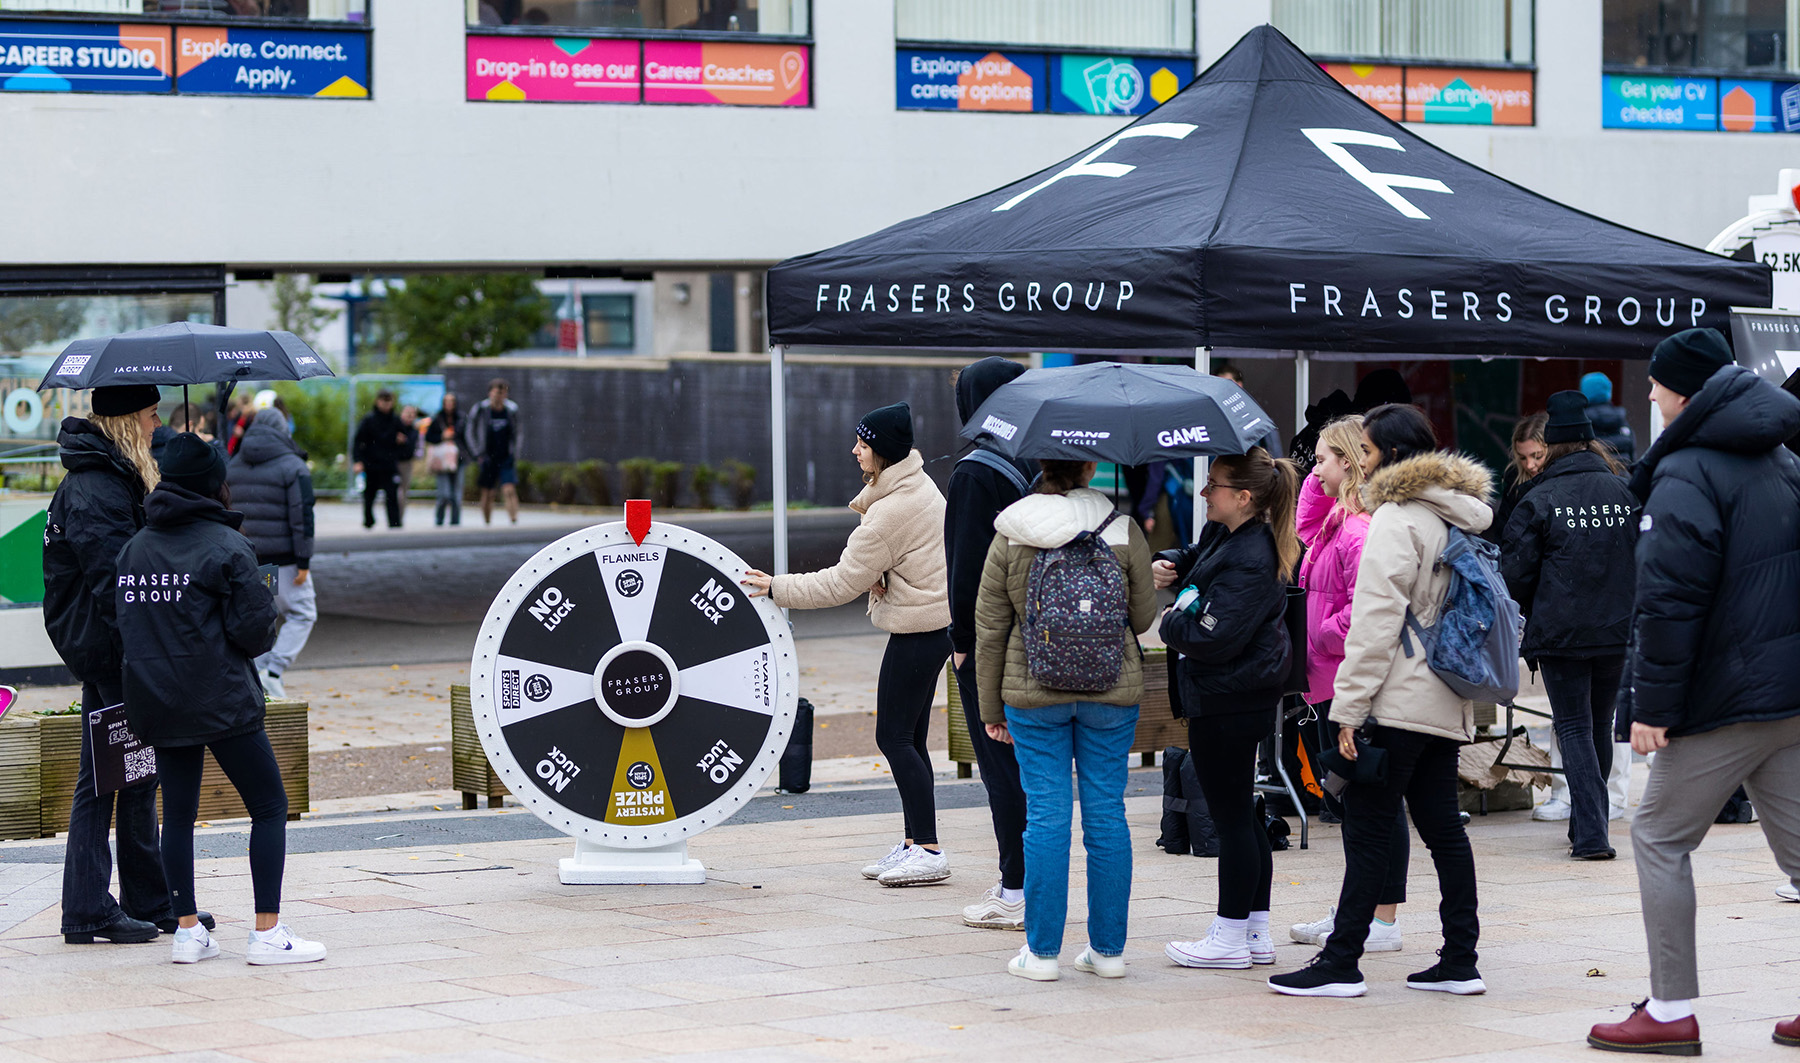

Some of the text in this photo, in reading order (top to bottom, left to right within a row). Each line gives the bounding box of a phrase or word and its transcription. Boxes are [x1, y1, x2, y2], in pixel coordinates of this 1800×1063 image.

[77, 48, 155, 69] STUDIO
[181, 37, 347, 62] Explore. Connect.
[235, 65, 296, 90] Apply.
[476, 58, 636, 81] Drop-in to see our
[645, 62, 775, 83] Career Coaches
[911, 56, 1012, 79] Explore your
[911, 82, 1033, 104] career options
[1405, 81, 1441, 103] with
[1443, 87, 1530, 109] employers
[1620, 81, 1708, 104] Get your CV
[1620, 104, 1684, 124] checked
[991, 122, 1199, 213] F
[1301, 127, 1455, 221] F
[816, 280, 1135, 313] FRASERS GROUP
[1288, 281, 1707, 328] FRASERS GROUP
[1751, 321, 1790, 334] FRASERS
[215, 350, 267, 360] FRASERS
[1050, 429, 1110, 439] EVANS
[1157, 426, 1210, 447] GAME
[1555, 504, 1631, 517] FRASERS
[1566, 517, 1625, 529] GROUP
[602, 551, 659, 564] FLANNELS
[118, 573, 190, 587] FRASERS
[124, 590, 182, 602] GROUP
[527, 586, 564, 623] NO
[699, 577, 736, 613] NO
[543, 599, 576, 632] LUCK
[690, 593, 722, 626] LUCK
[502, 672, 510, 707] SPORTS
[511, 672, 520, 707] DIRECT
[607, 673, 665, 688] FRASERS
[615, 684, 660, 696] GROUP
[753, 660, 761, 699] CYCLES
[762, 652, 770, 707] EVANS
[108, 721, 122, 730] SPIN
[548, 745, 581, 777] LUCK
[696, 739, 728, 772] LUCK
[710, 749, 744, 784] NO
[536, 760, 571, 794] NO
[615, 790, 664, 806] PRIZE
[615, 806, 665, 818] MYSTERY
